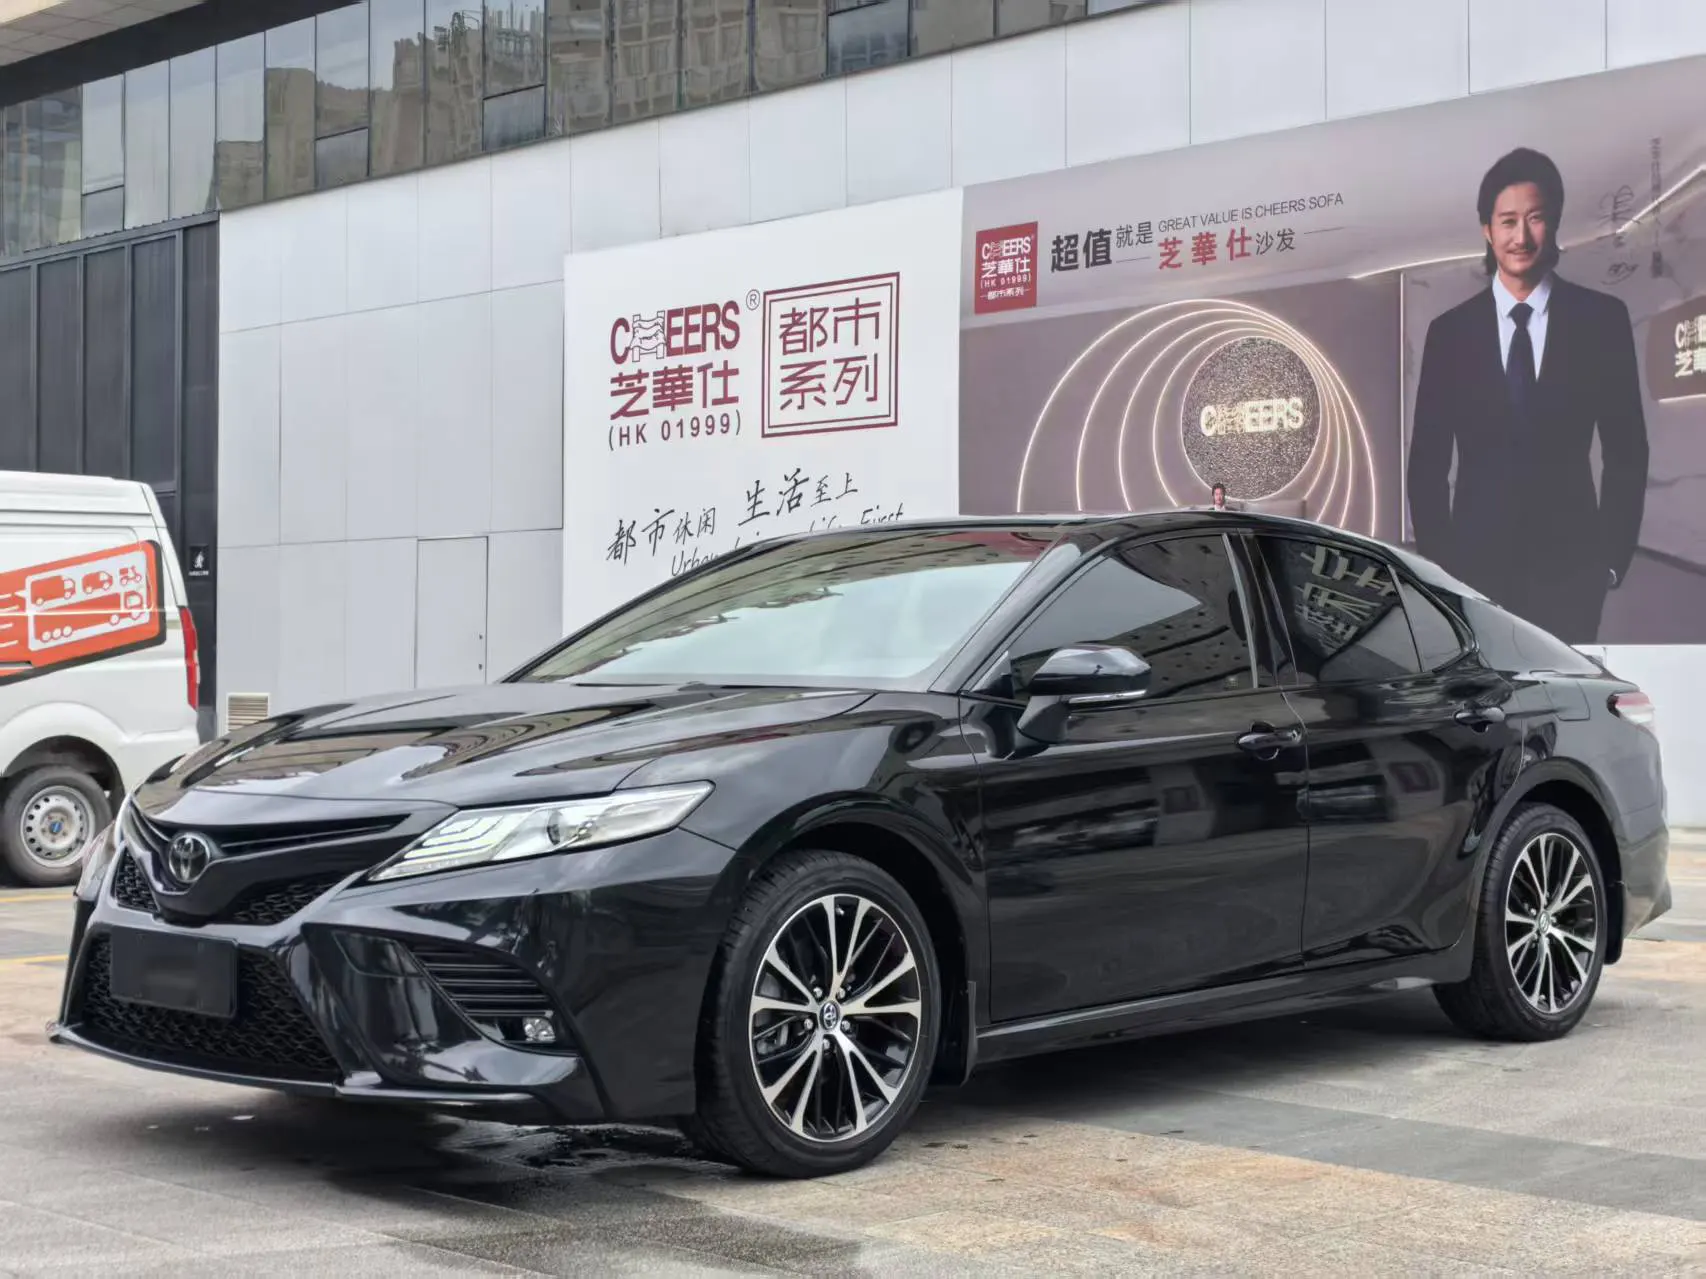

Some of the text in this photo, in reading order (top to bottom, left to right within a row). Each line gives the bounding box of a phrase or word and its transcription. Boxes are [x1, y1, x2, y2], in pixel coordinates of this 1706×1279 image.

[1158, 192, 1344, 233] GREAT VALUE IS CHEERS SOFA
[981, 256, 1031, 279] 芝華仕
[611, 300, 741, 365] CHEERS
[779, 297, 881, 355] 都市
[610, 360, 740, 420] 芝華仕
[779, 353, 878, 411] 系列
[608, 409, 741, 451] (HK 01999)
[1200, 397, 1304, 437] CHEERS
[606, 467, 858, 566] 都市休闲 生活至上
